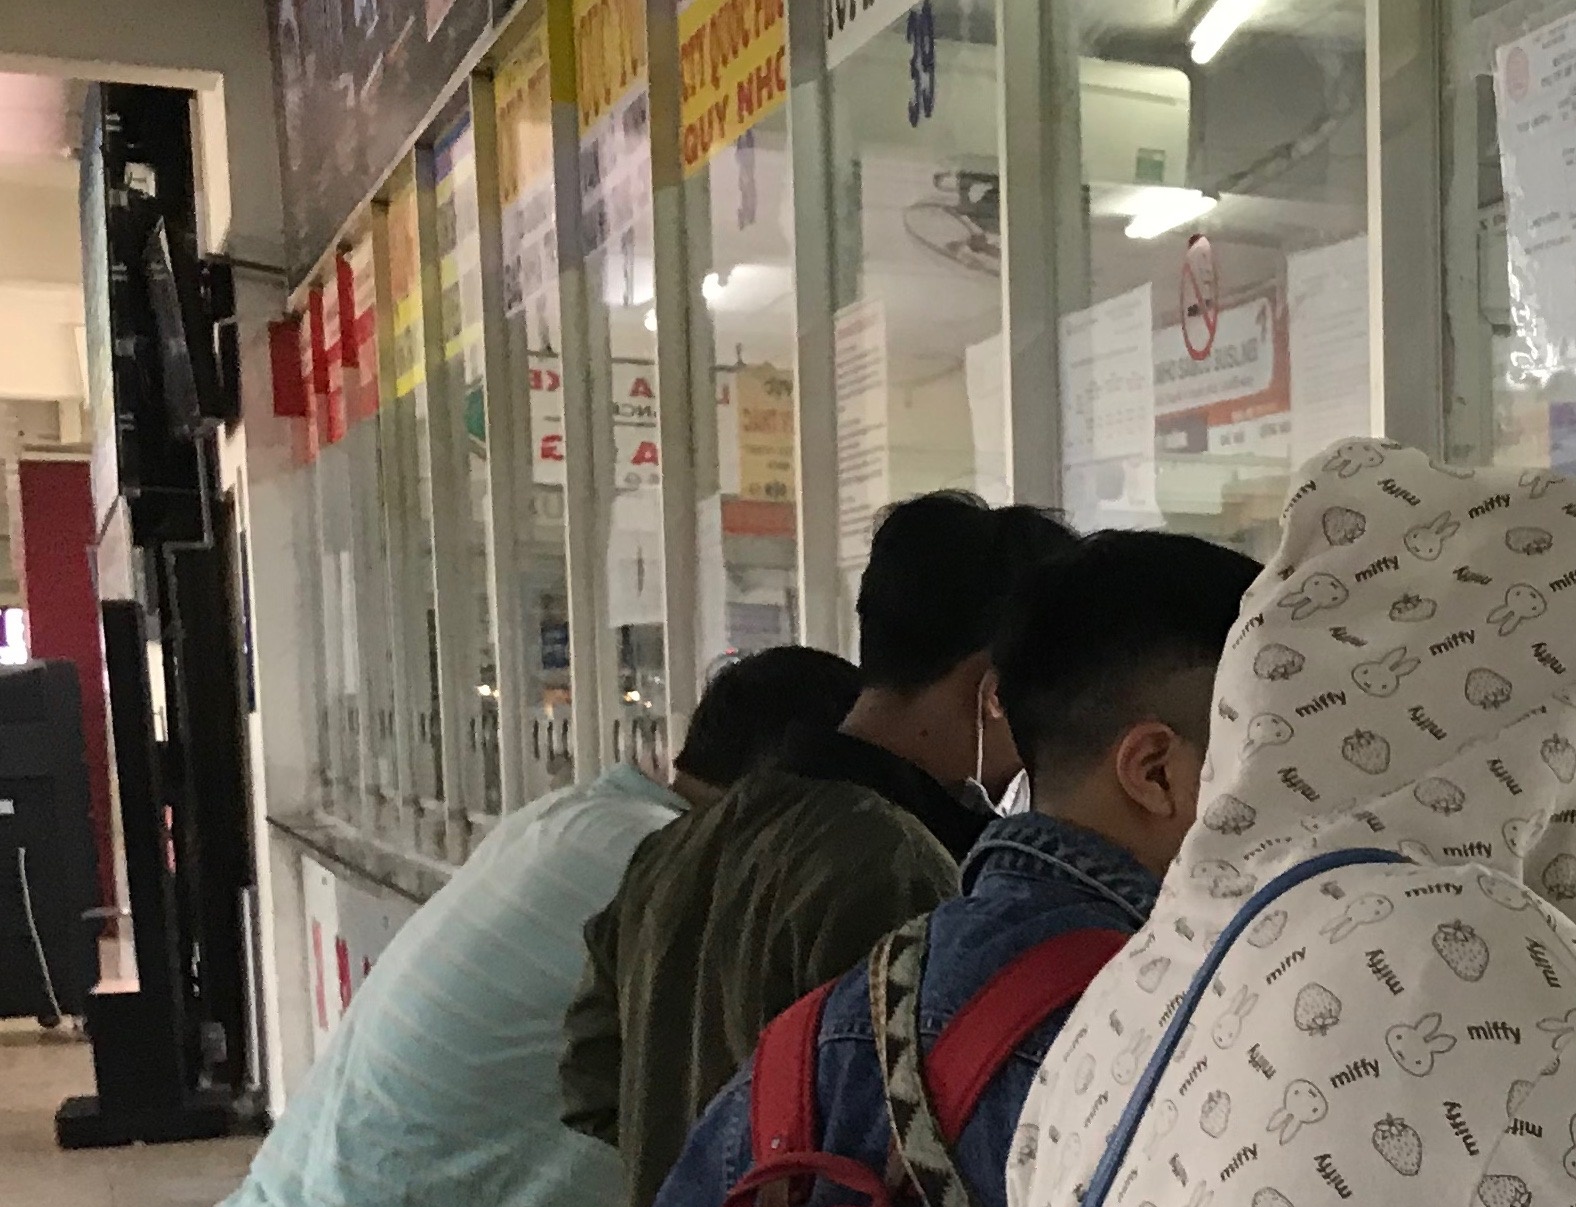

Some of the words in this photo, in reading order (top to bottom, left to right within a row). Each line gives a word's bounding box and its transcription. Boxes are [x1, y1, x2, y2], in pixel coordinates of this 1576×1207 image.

[1378, 478, 1421, 507] miffy
[1468, 493, 1511, 519] miffy
[1355, 555, 1400, 583] miffy
[1429, 629, 1475, 657] miffy
[1532, 642, 1566, 675] miffy
[1295, 690, 1347, 719] miffy
[1408, 704, 1447, 741] miffy
[1278, 766, 1320, 802] miffy
[1487, 758, 1522, 796] miffy
[1443, 841, 1492, 858] miffy
[1404, 882, 1463, 898] miffy
[1266, 946, 1307, 985] miffy
[1366, 949, 1404, 996] miffy
[1525, 937, 1561, 988] miffy
[1467, 1020, 1521, 1044] miffy
[1179, 1055, 1208, 1096] miffy
[1329, 1058, 1380, 1089] miffy
[1443, 1100, 1480, 1156] miffy
[1220, 1143, 1258, 1182] miffy
[1314, 1153, 1353, 1199] miffy
